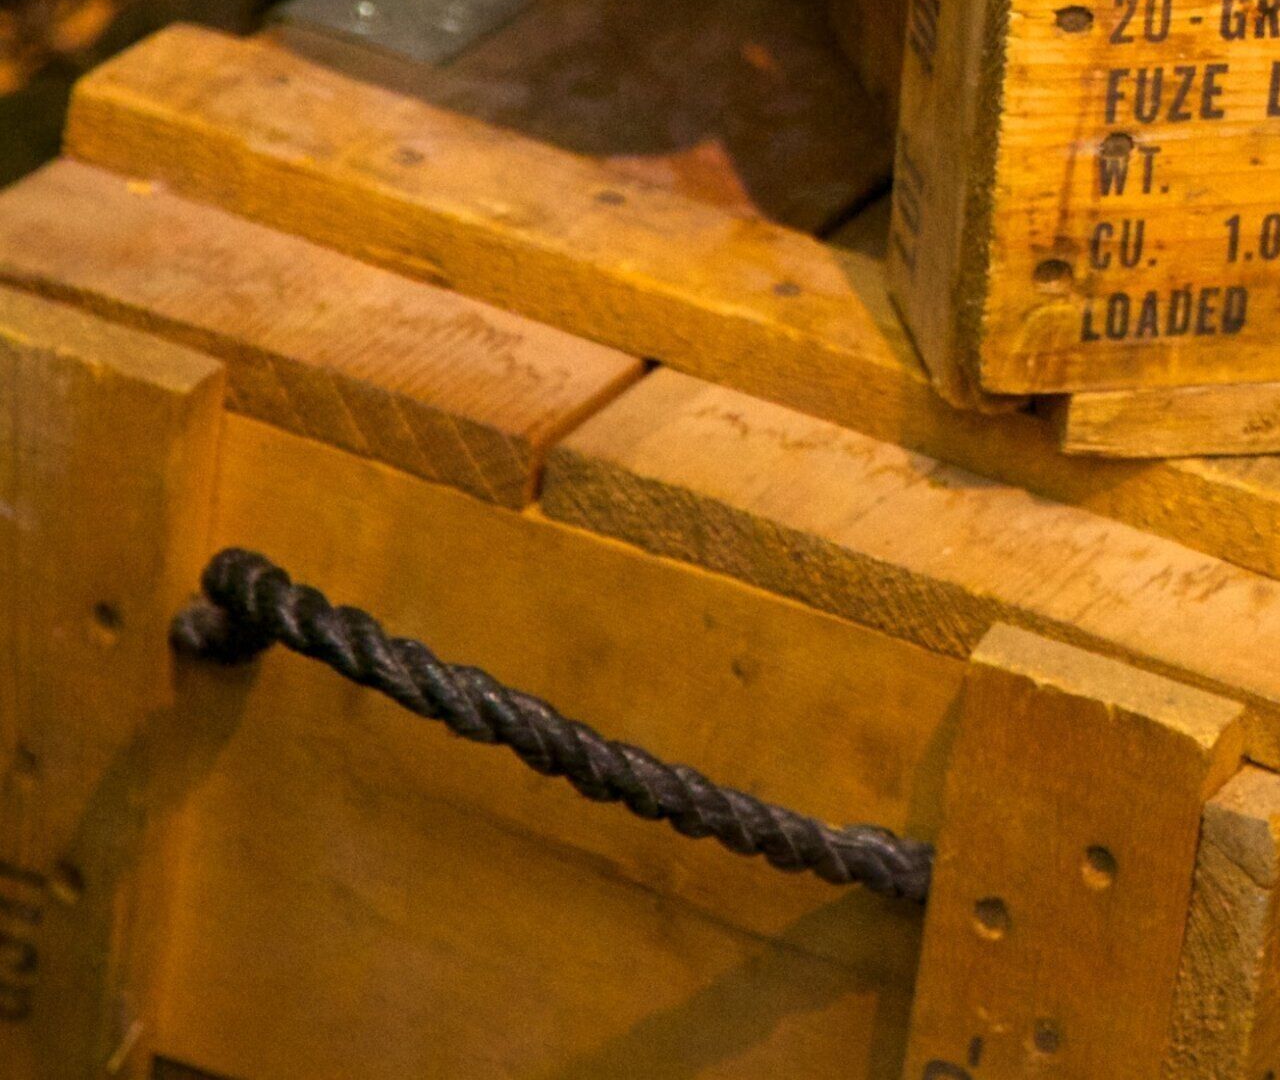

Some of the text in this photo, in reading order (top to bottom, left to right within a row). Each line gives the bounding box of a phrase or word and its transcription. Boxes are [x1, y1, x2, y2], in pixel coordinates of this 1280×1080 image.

[1104, 64, 1228, 125] FUZE
[1095, 145, 1170, 197] WT.
[1087, 221, 1158, 270] CU.
[1080, 284, 1249, 344] LOADED
